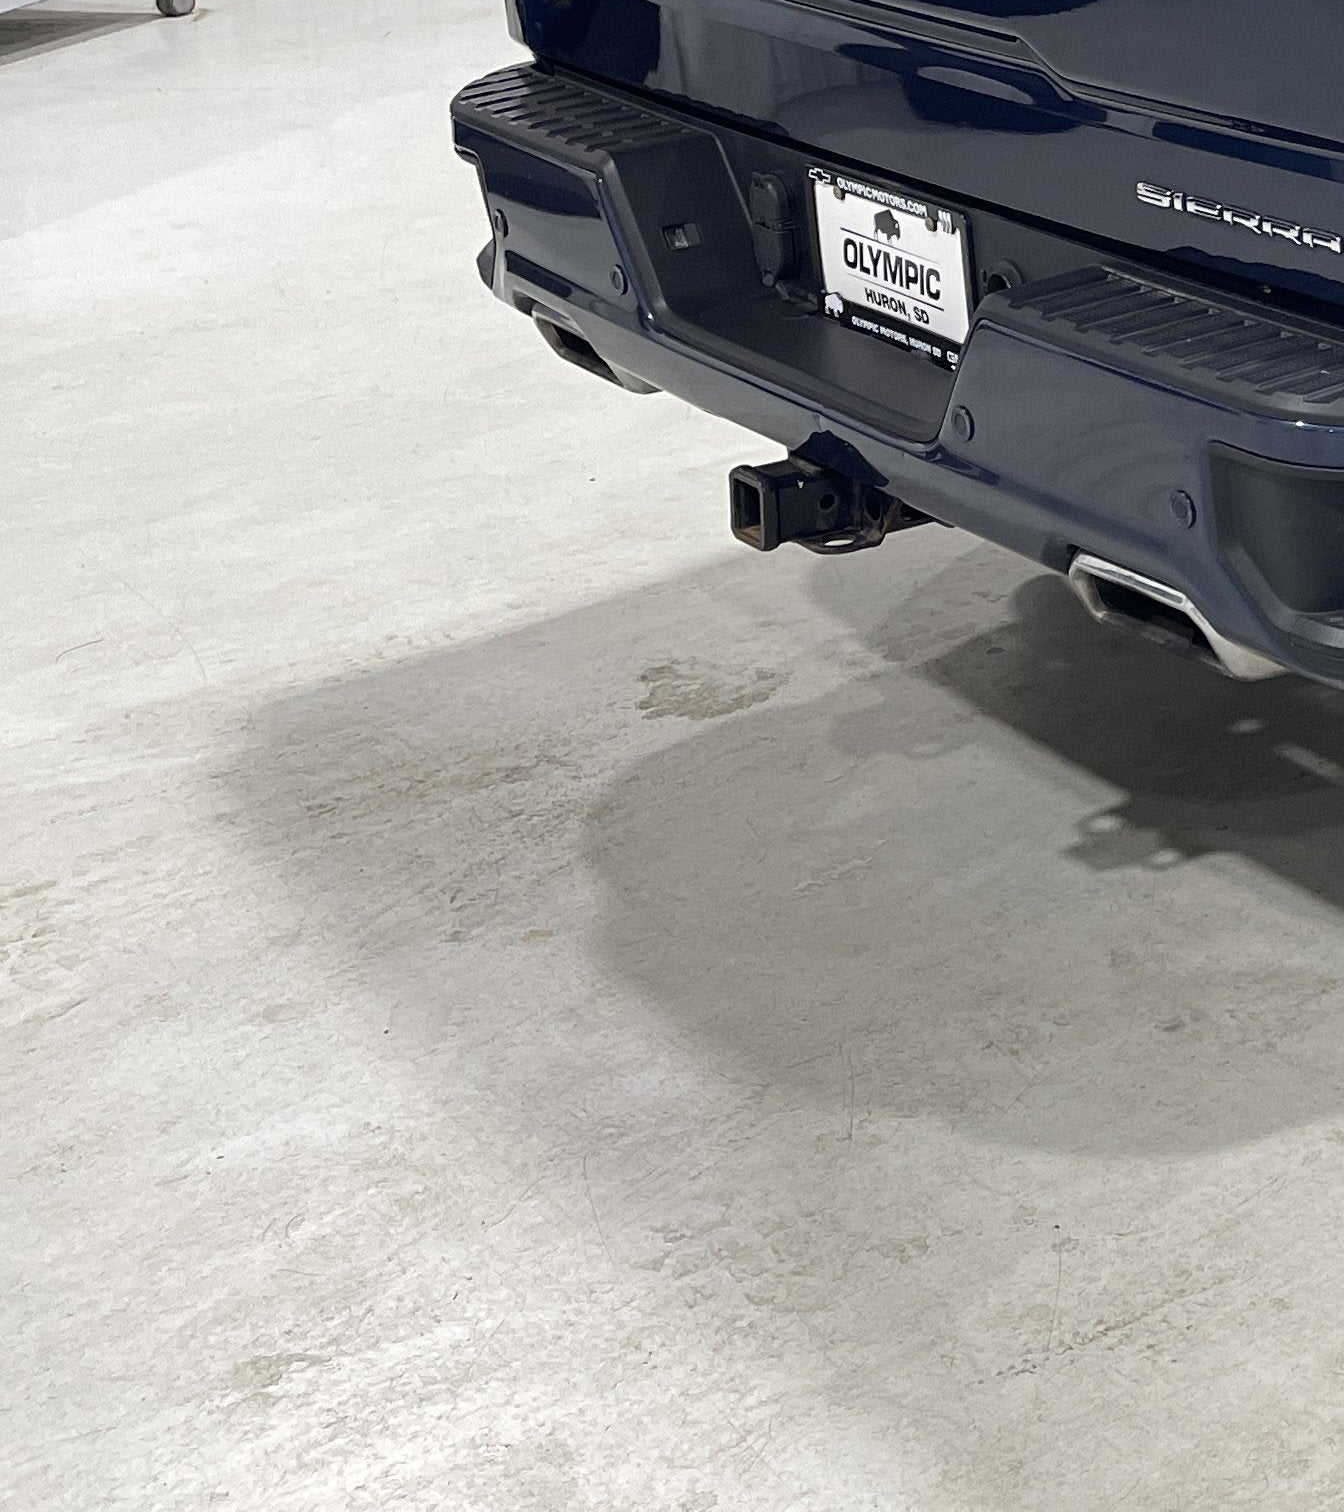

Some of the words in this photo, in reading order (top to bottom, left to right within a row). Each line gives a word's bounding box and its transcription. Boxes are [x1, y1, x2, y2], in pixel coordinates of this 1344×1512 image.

[836, 177, 928, 217] OLYMPICMOTORS.COM
[1136, 181, 1344, 254] SIERRA
[843, 237, 941, 301] OLYMPIC
[864, 287, 911, 322] HURON,
[914, 306, 930, 325] SD
